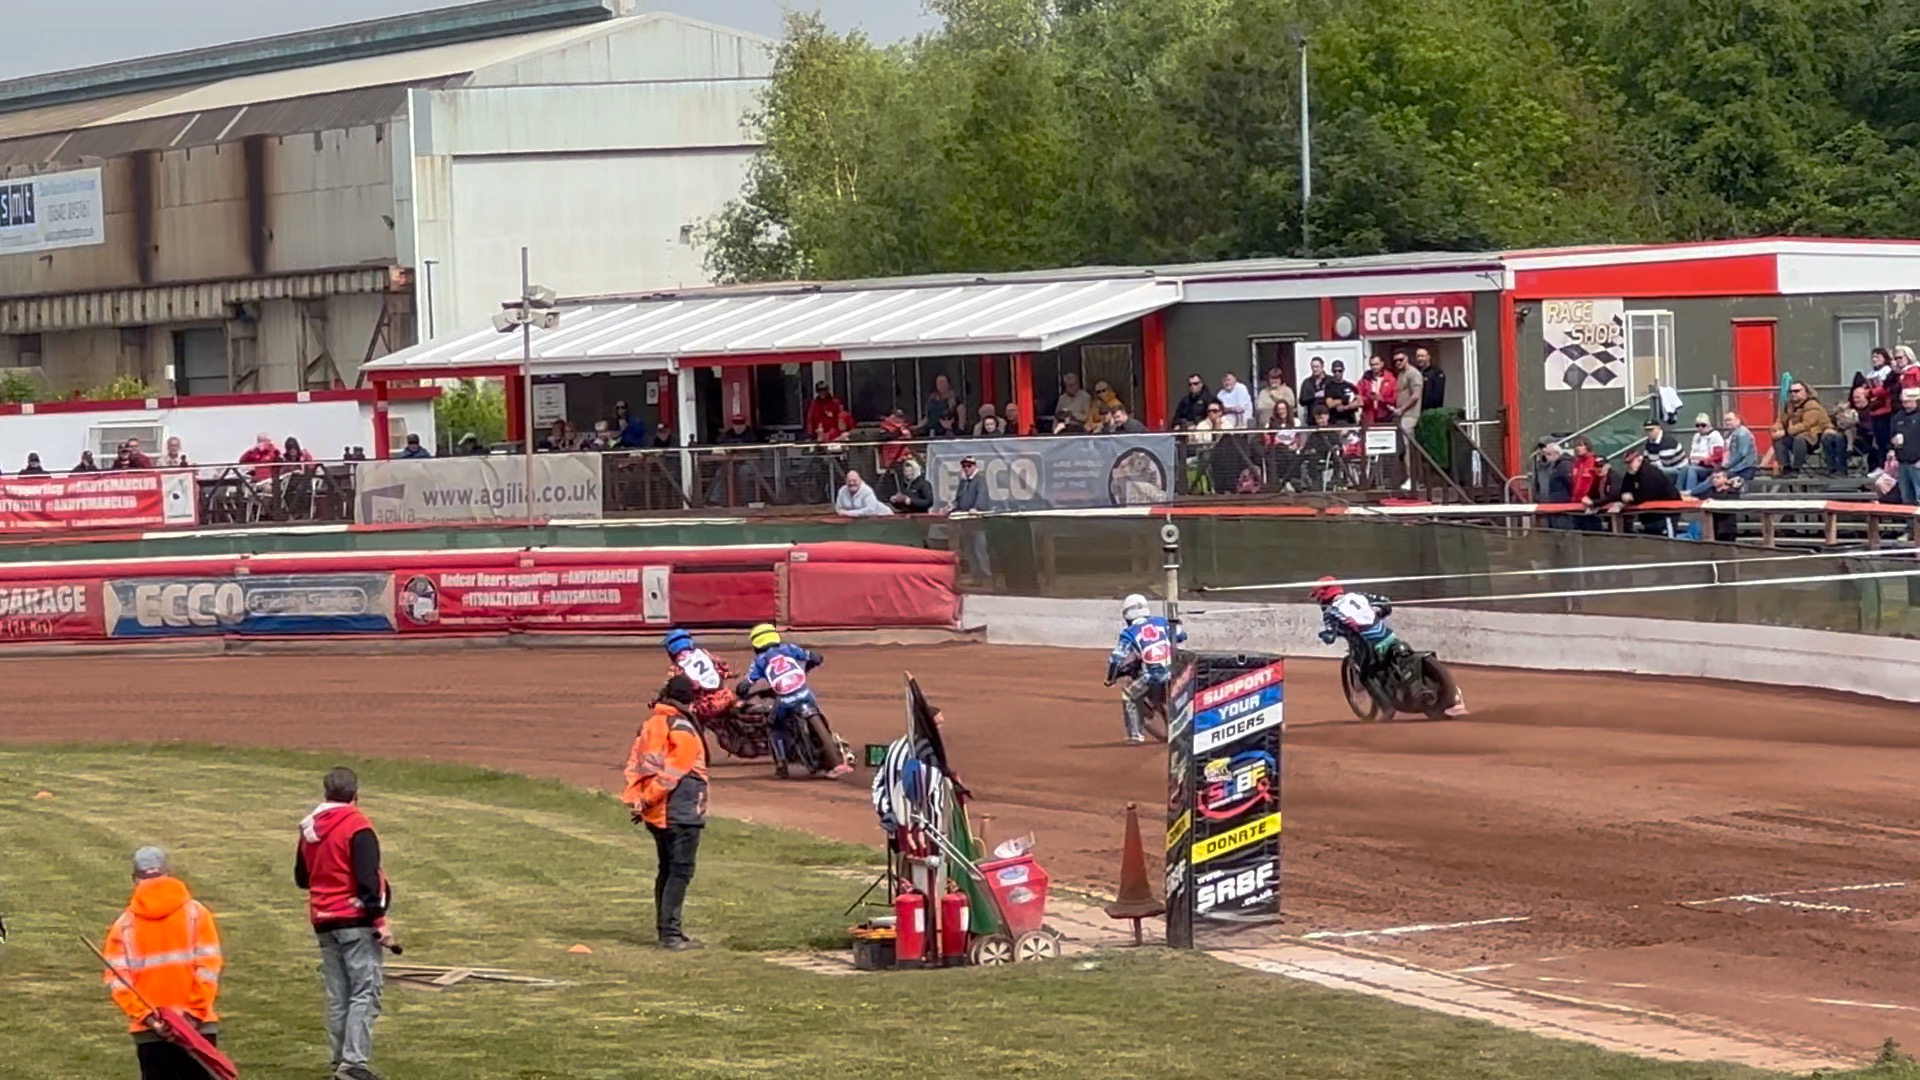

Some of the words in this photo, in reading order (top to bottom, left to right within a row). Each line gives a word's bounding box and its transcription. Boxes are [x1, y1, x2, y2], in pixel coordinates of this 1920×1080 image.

[1364, 307, 1421, 330] ECCO
[1425, 306, 1468, 328] BAR
[1547, 302, 1594, 323] RACE
[1571, 324, 1621, 345] SHOP
[939, 458, 1038, 501] ECO
[422, 479, 598, 508] www.agilia.co.uk
[440, 573, 475, 586] Redcar
[477, 572, 506, 586] Bears
[507, 571, 558, 587] supporting
[136, 583, 245, 627] ECCO
[1349, 599, 1361, 610] 1
[693, 661, 709, 675] 2
[1203, 667, 1274, 706] SUPPORT
[1218, 694, 1260, 720] YOUR
[1211, 713, 1265, 743] RIDERS
[1206, 820, 1267, 854] DONATE
[1197, 862, 1274, 914] SRBF
